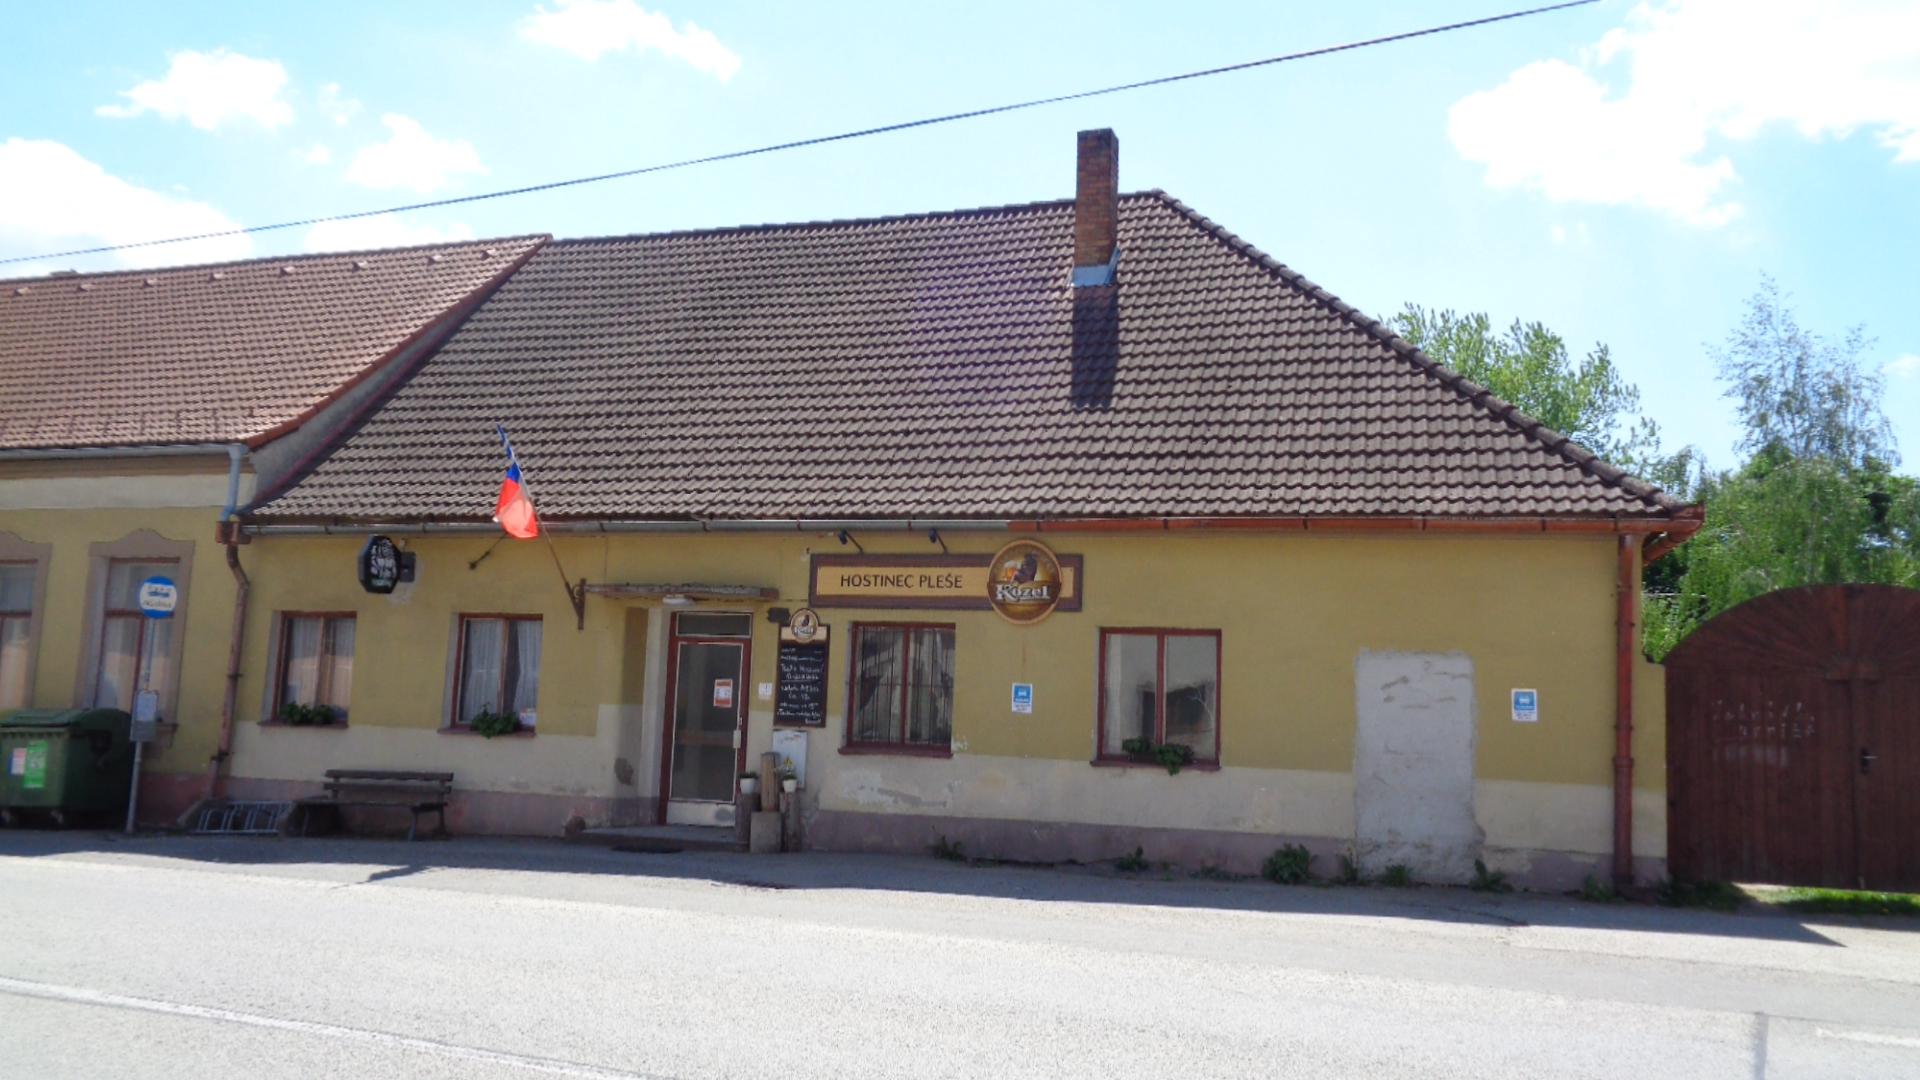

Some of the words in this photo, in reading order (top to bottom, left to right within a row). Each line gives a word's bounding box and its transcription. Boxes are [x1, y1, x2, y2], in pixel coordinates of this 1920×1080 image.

[840, 574, 914, 589] HOSTINEC
[919, 573, 963, 589] PLEŠE
[995, 584, 1050, 603] Kozel
